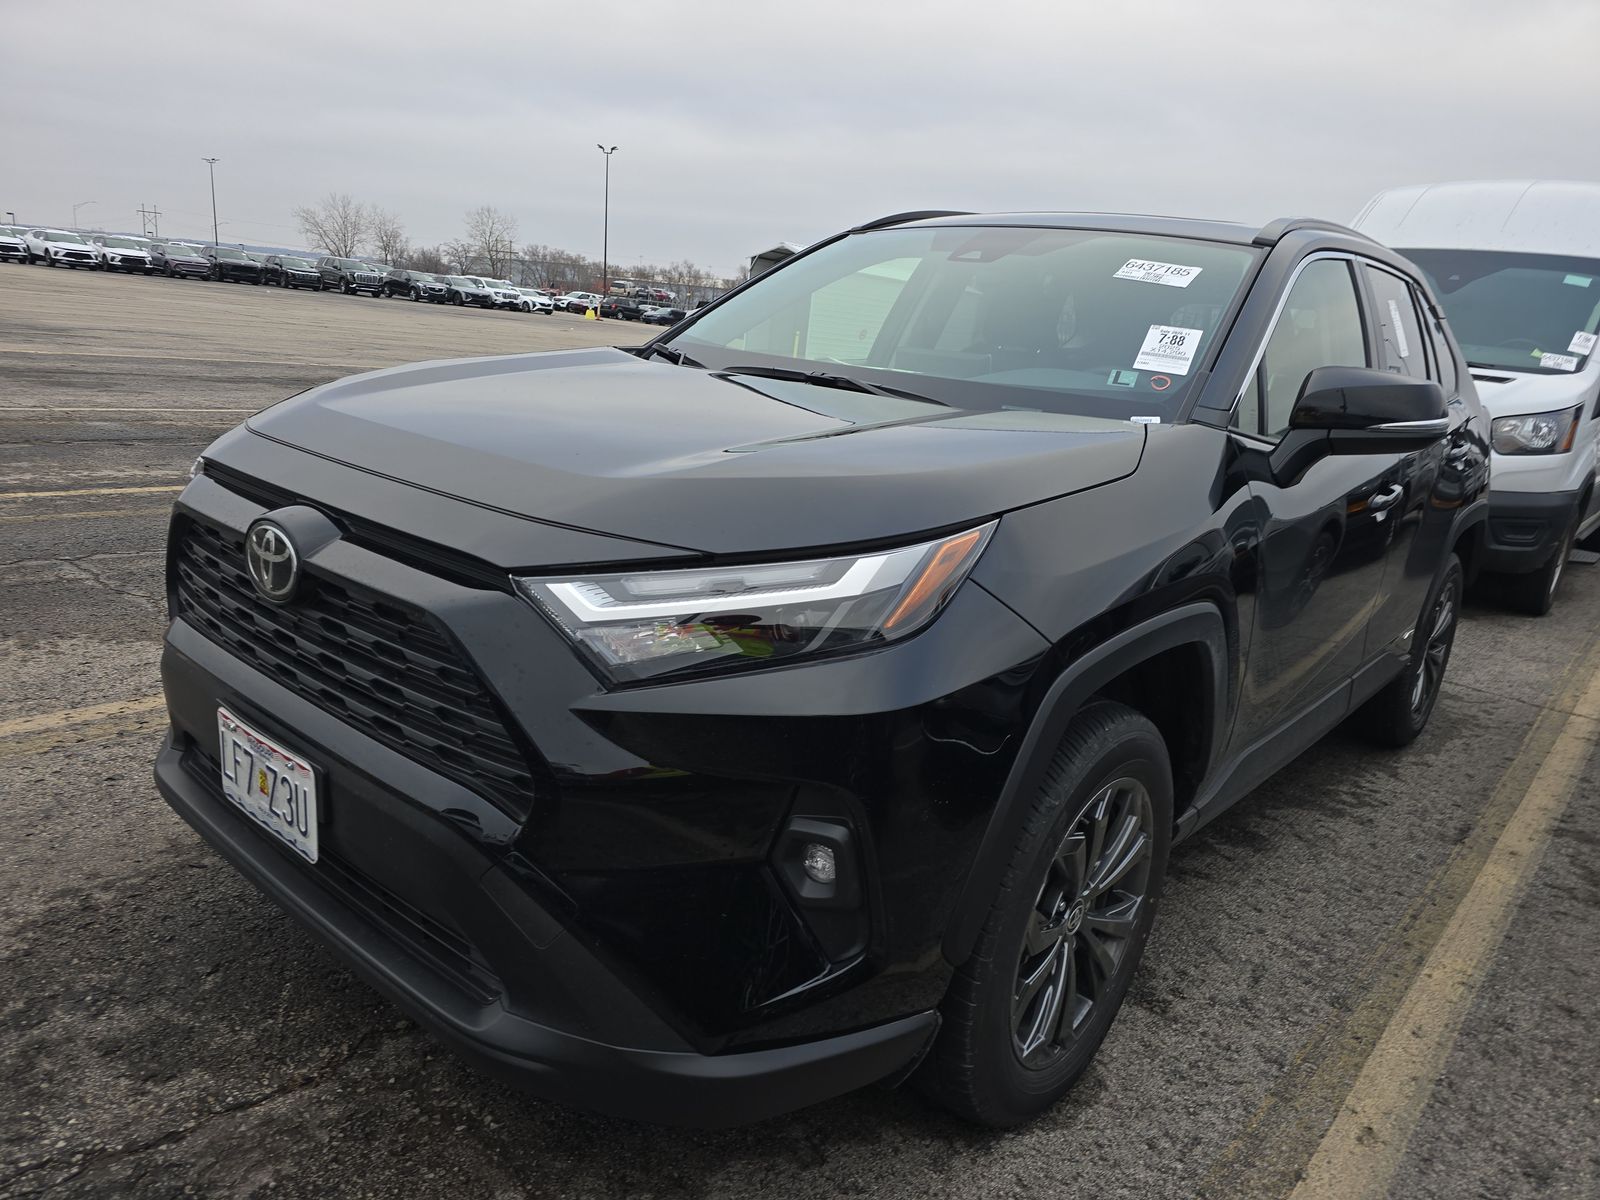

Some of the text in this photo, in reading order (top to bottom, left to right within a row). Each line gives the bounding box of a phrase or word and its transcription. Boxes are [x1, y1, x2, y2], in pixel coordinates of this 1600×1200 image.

[1125, 260, 1192, 277] 6437185
[1158, 333, 1186, 347] 7:88
[220, 730, 254, 797] LF7
[265, 765, 308, 837] Z3U
